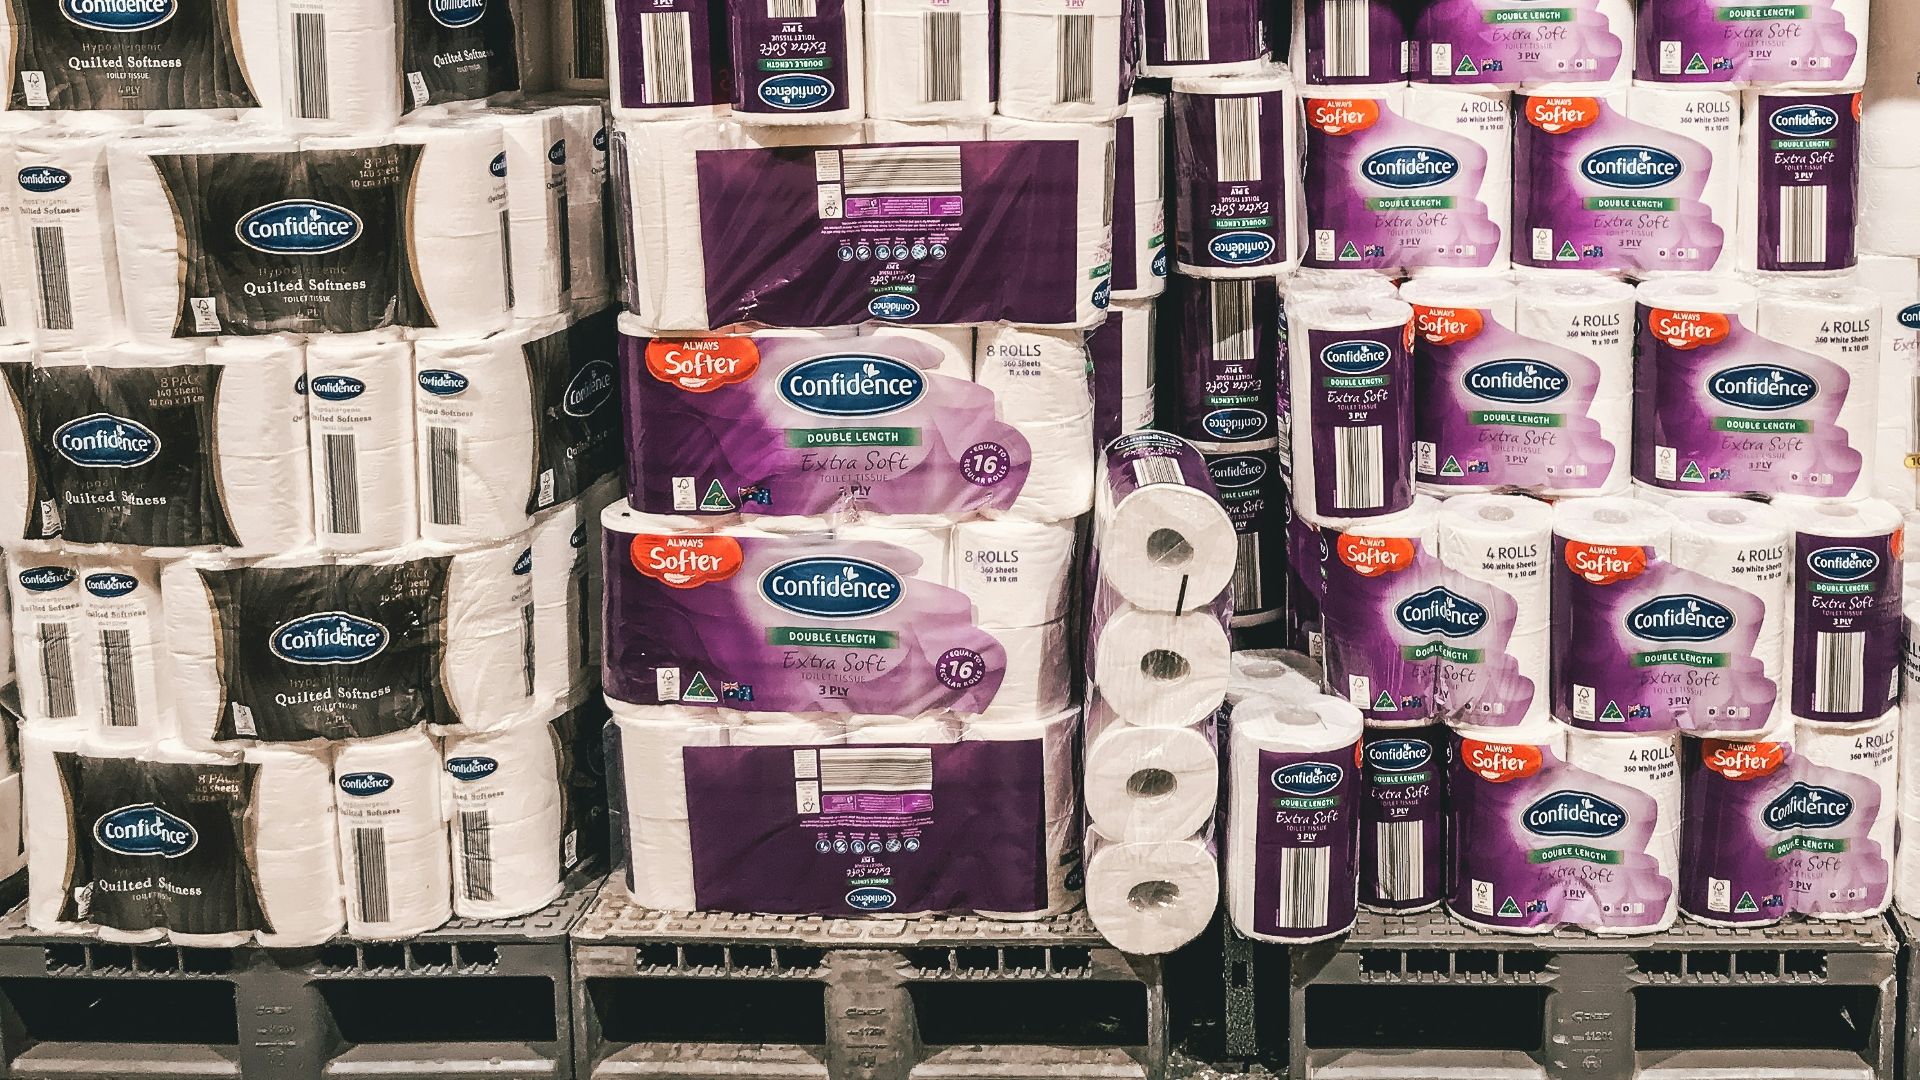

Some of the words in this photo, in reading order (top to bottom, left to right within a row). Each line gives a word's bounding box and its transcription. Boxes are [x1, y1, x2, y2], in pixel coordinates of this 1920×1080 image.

[1496, 12, 1528, 20] DOUBLE
[1530, 11, 1561, 20] LENGTH
[1729, 9, 1760, 18] DOUBLE
[1763, 8, 1795, 17] LENGTH
[1492, 27, 1531, 41] Extra
[1536, 25, 1568, 40] Soft
[1724, 25, 1763, 39] Extra
[1769, 23, 1801, 39] Soft
[68, 57, 123, 69] Quilted
[127, 56, 182, 68] Softness
[765, 86, 828, 100] Confidence
[1461, 103, 1468, 113] 4
[1472, 100, 1504, 113] ROLLS
[1546, 98, 1572, 106] ALWAYS
[1685, 102, 1693, 113] 4
[1697, 101, 1730, 113] ROLLS
[1316, 107, 1365, 124] Softer
[1535, 107, 1585, 123] Softer
[1774, 152, 1806, 164] Extra
[1809, 151, 1835, 165] Soft
[1368, 158, 1451, 176] Confidence
[1587, 158, 1674, 175] Confidence
[1210, 203, 1235, 216] Soft
[1237, 202, 1269, 214] Extra
[1379, 199, 1410, 208] DOUBLE
[1412, 199, 1441, 208] LENGTH
[1598, 199, 1629, 208] DOUBLE
[1631, 200, 1663, 208] LENGTH
[248, 217, 352, 239] Confidence
[1214, 241, 1270, 255] Confidence
[1619, 239, 1624, 247] 3
[1626, 239, 1642, 247] PLY
[244, 279, 303, 297] Quilted
[309, 279, 366, 291] Softness
[310, 295, 331, 303] TISSUE
[1429, 309, 1455, 317] ALWAYS
[1572, 317, 1579, 327] 4
[1583, 313, 1620, 327] ROLLS
[1672, 312, 1701, 321] ALWAYS
[1418, 316, 1468, 334] Softer
[1659, 320, 1714, 338] Softer
[1820, 322, 1830, 333] 4
[1833, 319, 1870, 333] ROLLS
[683, 341, 719, 351] ALWAYS
[1815, 336, 1827, 344] 360
[1829, 336, 1849, 344] White
[1850, 335, 1869, 343] Sheets
[987, 345, 995, 356] 8
[999, 344, 1041, 357] ROLLS
[664, 351, 739, 376] Softer
[1018, 360, 1041, 368] Sheets
[789, 372, 913, 396] Confidence
[1471, 372, 1562, 390] Confidence
[1715, 377, 1808, 396] Confidence
[1328, 391, 1359, 403] Extra
[1362, 389, 1388, 404] Soft
[1348, 412, 1353, 420] 3
[1355, 411, 1368, 420] PLY
[1483, 413, 1515, 422] DOUBLE
[1517, 415, 1550, 424] LENGTH
[1726, 420, 1761, 430] DOUBLE
[1763, 421, 1796, 430] LENGTH
[807, 433, 851, 443] DOUBLE
[855, 432, 899, 443] LENGTH
[1478, 429, 1519, 443] Extra
[1524, 430, 1557, 446] Soft
[1721, 436, 1763, 451] Extra
[1769, 436, 1803, 451] Soft
[973, 444, 998, 453] EQUAL
[999, 447, 1007, 459] TO
[801, 453, 857, 471] Extra
[864, 450, 910, 471] Soft
[974, 454, 997, 474] 16
[1504, 455, 1510, 463] 3
[1512, 455, 1528, 463] PLY
[65, 491, 115, 504] Quilted
[851, 486, 871, 496] PLY
[667, 539, 704, 548] ALWAYS
[1359, 539, 1385, 547] ALWAYS
[965, 550, 973, 563] 8
[978, 550, 1019, 563] ROLLS
[1347, 545, 1400, 566] Softer
[1486, 547, 1494, 559] 4
[1498, 544, 1537, 559] ROLLS
[1589, 546, 1617, 555] ALWAYS
[1737, 551, 1745, 562] 4
[1749, 546, 1783, 562] ROLLS
[649, 546, 722, 572] Softer
[1496, 562, 1515, 570] White
[1516, 560, 1537, 568] Sheets
[1576, 552, 1632, 574] Softer
[1746, 564, 1765, 573] White
[1766, 562, 1782, 571] Sheets
[771, 575, 891, 599] Confidence
[1811, 595, 1846, 609] Extra
[1849, 596, 1874, 610] Soft
[1403, 600, 1480, 626] Confidence
[1634, 607, 1726, 629] Confidence
[281, 627, 378, 650] Confidence
[789, 632, 832, 643] DOUBLE
[835, 633, 876, 644] LENGTH
[782, 651, 836, 670] Extra
[843, 652, 887, 672] Soft
[949, 649, 974, 658] EQUAL
[973, 653, 982, 664] TO
[1645, 652, 1678, 663] DOUBLE
[1680, 653, 1713, 664] LENGTH
[949, 661, 974, 679] 16
[1444, 665, 1476, 683] Soft
[275, 688, 332, 707] Quilted
[338, 685, 391, 699] Softness
[819, 686, 826, 695] 3
[829, 687, 850, 696] PLY
[1668, 697, 1673, 706] 3
[1675, 697, 1691, 705] PLY
[1854, 738, 1863, 749] 4
[1866, 730, 1894, 748] ROLLS
[1485, 744, 1513, 754] ALWAYS
[1629, 750, 1637, 761] 4
[1641, 744, 1675, 761] ROLLS
[1728, 743, 1757, 753] ALWAYS
[1472, 750, 1527, 771] Softer
[1713, 749, 1769, 769] Softer
[1278, 771, 1337, 784] Confidence
[1530, 803, 1618, 827] Confidence
[1770, 796, 1847, 822] Confidence
[1276, 811, 1309, 824] Extra
[1312, 810, 1339, 825] Soft
[1542, 848, 1572, 860] DOUBLE
[1575, 849, 1606, 861] LENGTH
[1538, 866, 1576, 881] Extra
[1581, 864, 1614, 882] Soft
[99, 878, 152, 892] Quilted
[1788, 881, 1794, 889] 3
[1796, 881, 1813, 890] PLY
[1571, 890, 1585, 898] PLY
